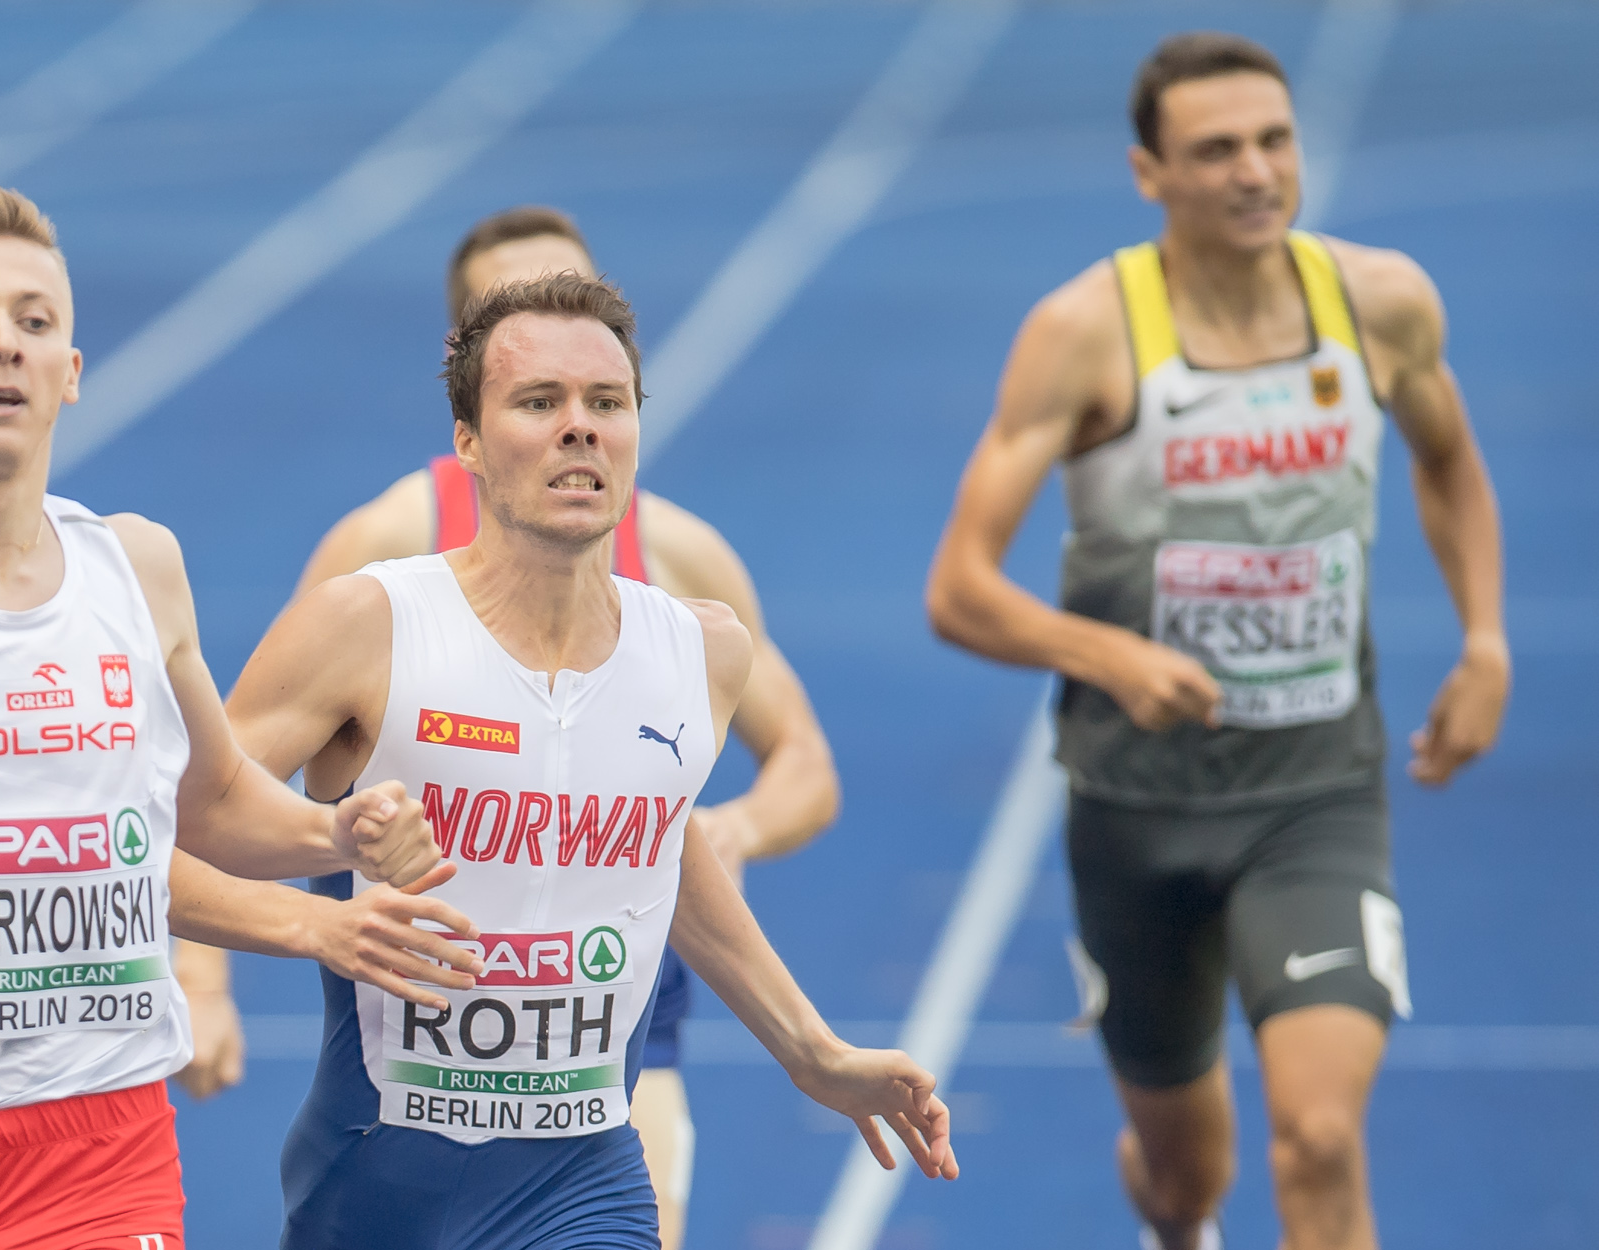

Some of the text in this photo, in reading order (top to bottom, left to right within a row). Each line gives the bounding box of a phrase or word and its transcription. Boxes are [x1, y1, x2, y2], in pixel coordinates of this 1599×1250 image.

[1164, 422, 1348, 487] GERMANY
[9, 692, 71, 710] ORLEN
[457, 723, 516, 746] EXTRA
[421, 782, 687, 868] NORWAY
[416, 939, 569, 978] PAR
[78, 991, 153, 1023] 2018
[402, 993, 615, 1061] ROTH
[450, 1071, 496, 1089] RUN
[405, 1092, 607, 1130] BERLIN 2018
